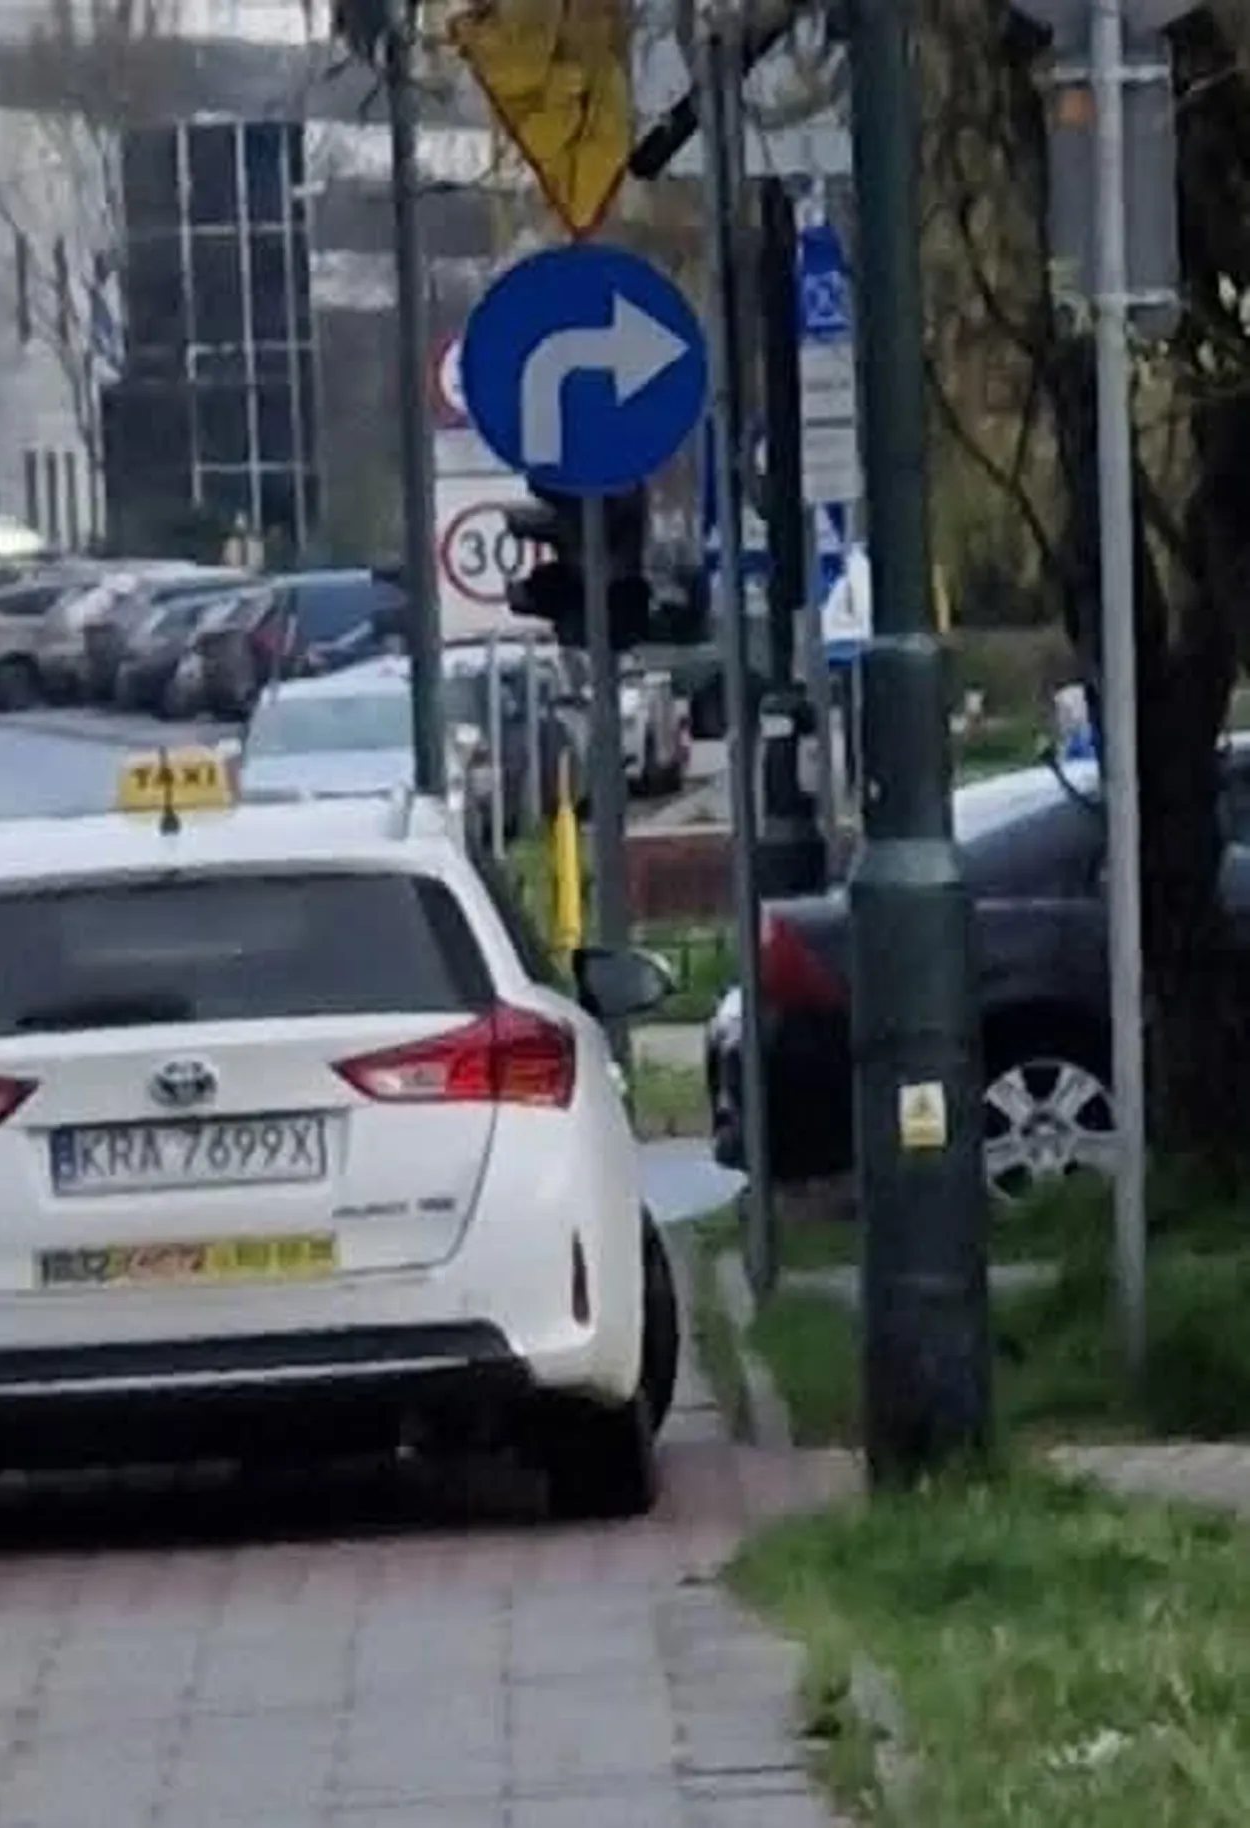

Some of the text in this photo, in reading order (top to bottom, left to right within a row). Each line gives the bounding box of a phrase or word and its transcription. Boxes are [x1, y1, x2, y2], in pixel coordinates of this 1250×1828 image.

[458, 529, 525, 577] 30
[130, 764, 217, 790] TAXI
[81, 1118, 314, 1176] KRA 7699X
